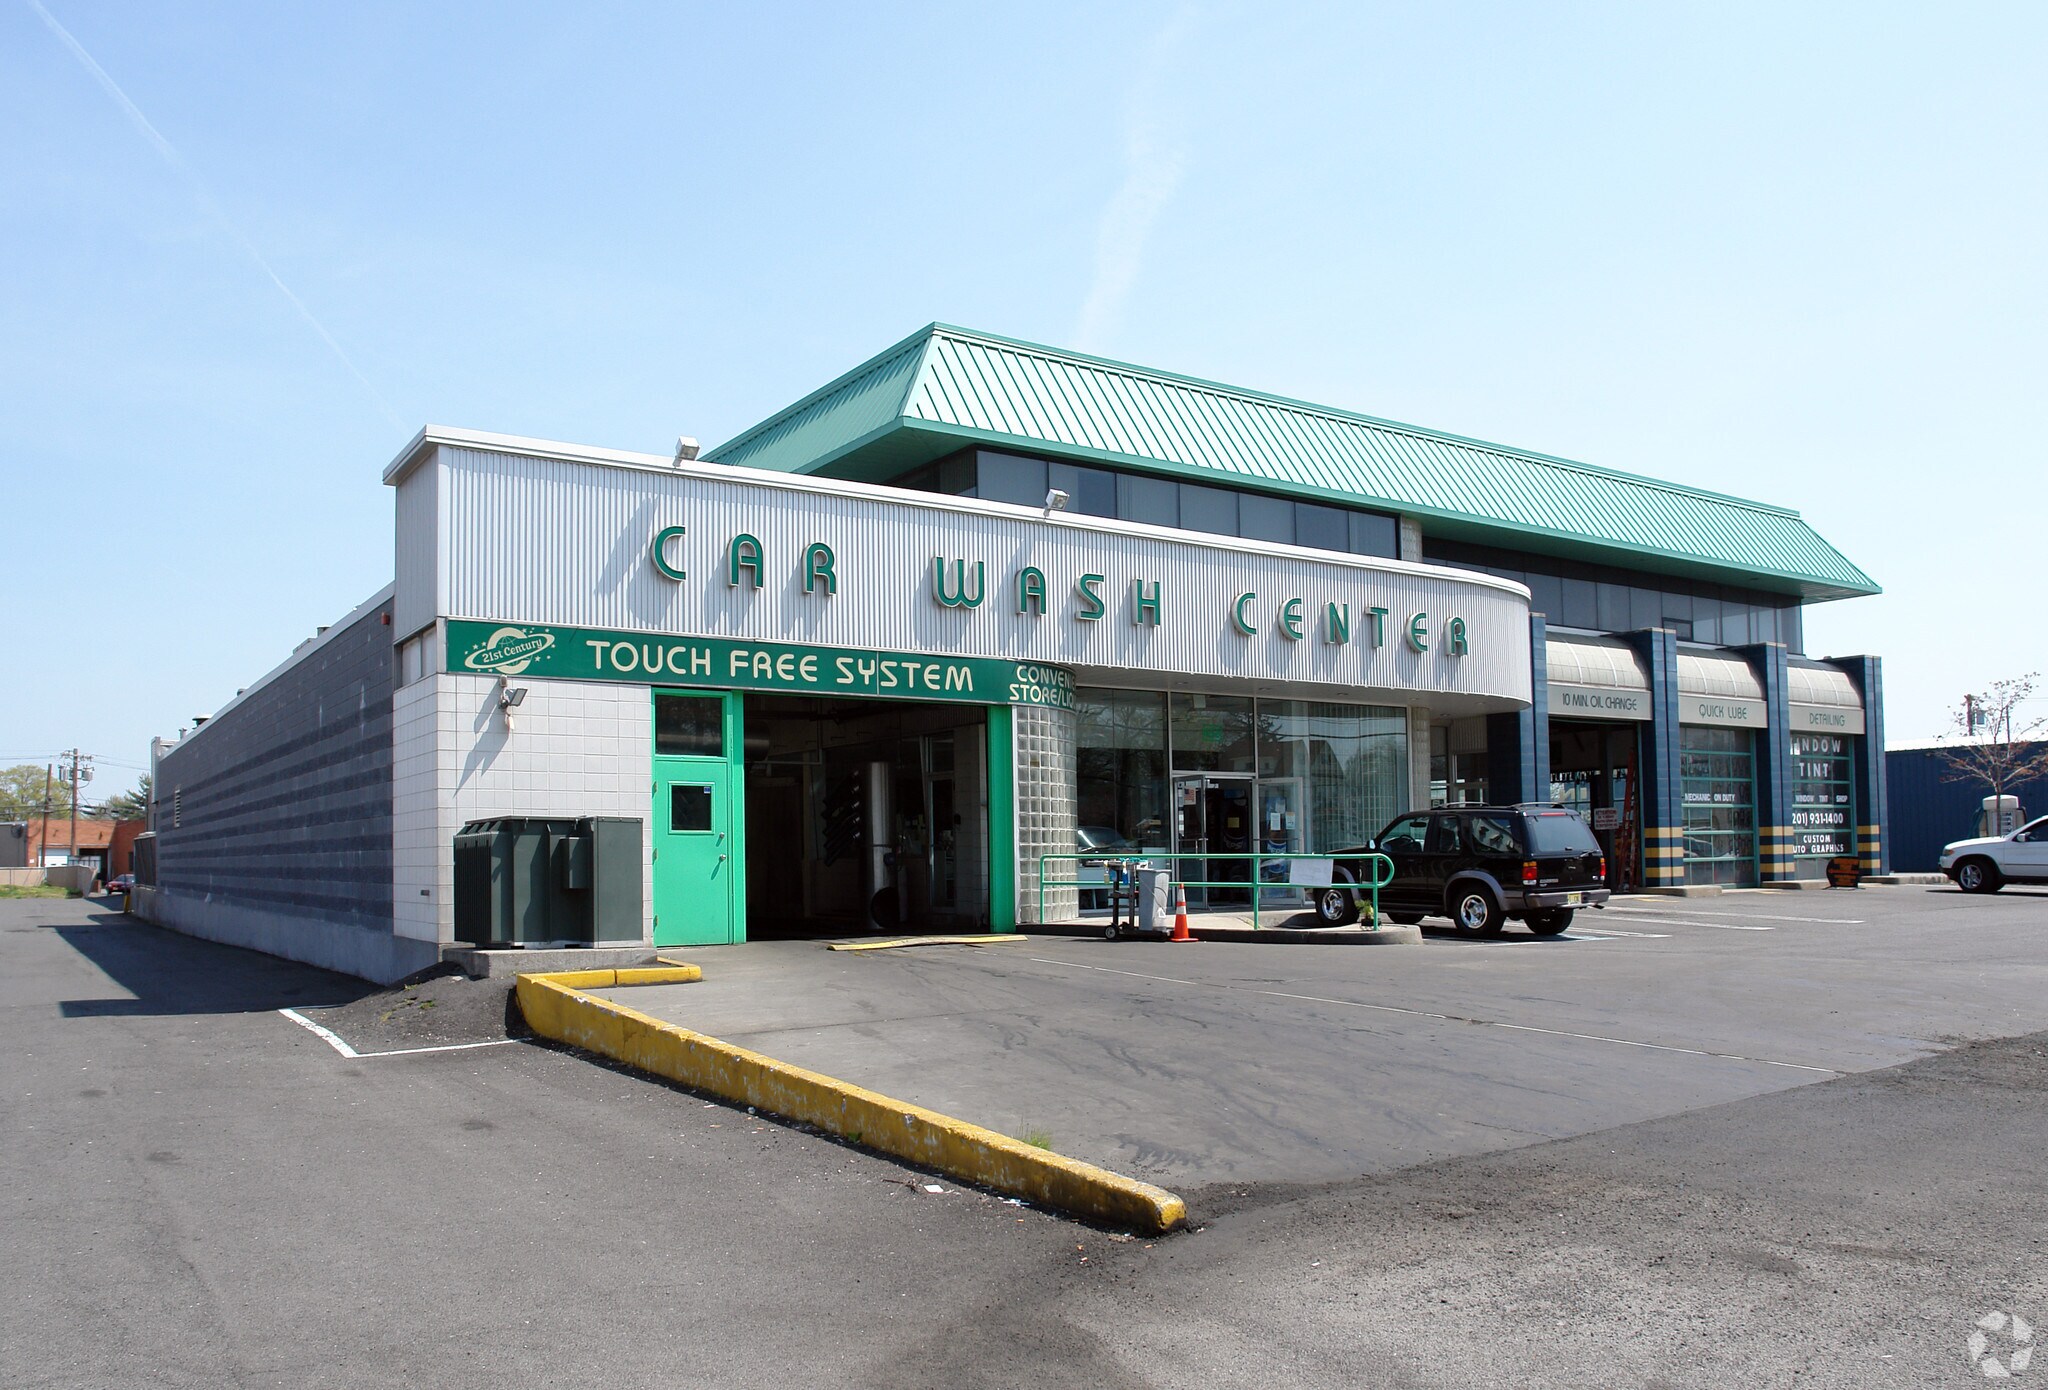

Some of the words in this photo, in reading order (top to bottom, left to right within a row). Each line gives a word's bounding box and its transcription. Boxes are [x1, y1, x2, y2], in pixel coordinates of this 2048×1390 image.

[651, 525, 837, 596] CAR
[932, 556, 1161, 627] WASH
[1231, 592, 1468, 656] CENTER
[482, 651, 504, 663] 21st
[504, 638, 543, 657] Century
[586, 640, 711, 676] TOUCH
[730, 649, 818, 682] FREE
[836, 657, 974, 692] SYSTEM
[1562, 693, 1571, 706] 10
[1590, 695, 1604, 709] OIL
[1605, 696, 1638, 711] CHANGE
[1698, 703, 1725, 719] QUICK
[1727, 706, 1748, 720] LUBE
[1809, 712, 1846, 727] DETAILING
[1799, 762, 1829, 777] TINT
[1713, 793, 1722, 802] ON
[1722, 793, 1736, 802] DUTY
[1792, 812, 1808, 826] 201)
[1809, 812, 1844, 825] 931-1400
[1803, 834, 1831, 844] CUSTOM
[1792, 844, 1806, 854] UTO
[1811, 844, 1844, 853] GRAPHICS
